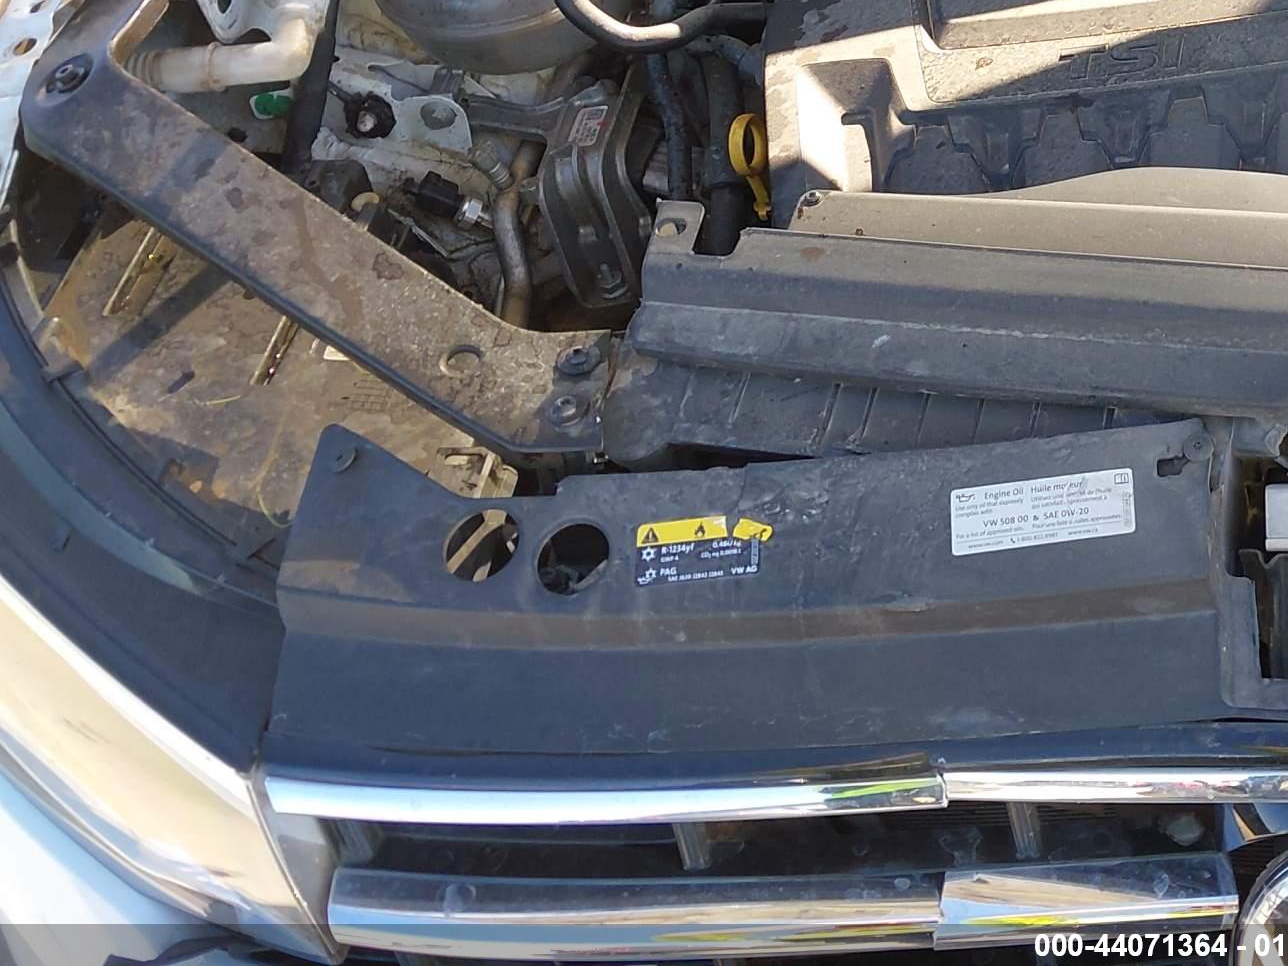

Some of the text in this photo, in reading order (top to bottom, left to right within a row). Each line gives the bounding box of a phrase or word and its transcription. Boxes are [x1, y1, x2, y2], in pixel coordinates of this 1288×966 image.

[1059, 35, 1185, 80] TSI
[1031, 484, 1051, 493] Huile
[985, 490, 1010, 500] Engine
[983, 519, 998, 528] VW
[1001, 516, 1015, 525] 508
[1043, 511, 1057, 520] SAE
[1061, 507, 1089, 517] 0W-20
[661, 543, 694, 554] R-1234yf
[660, 565, 758, 575] PAG VW AG
